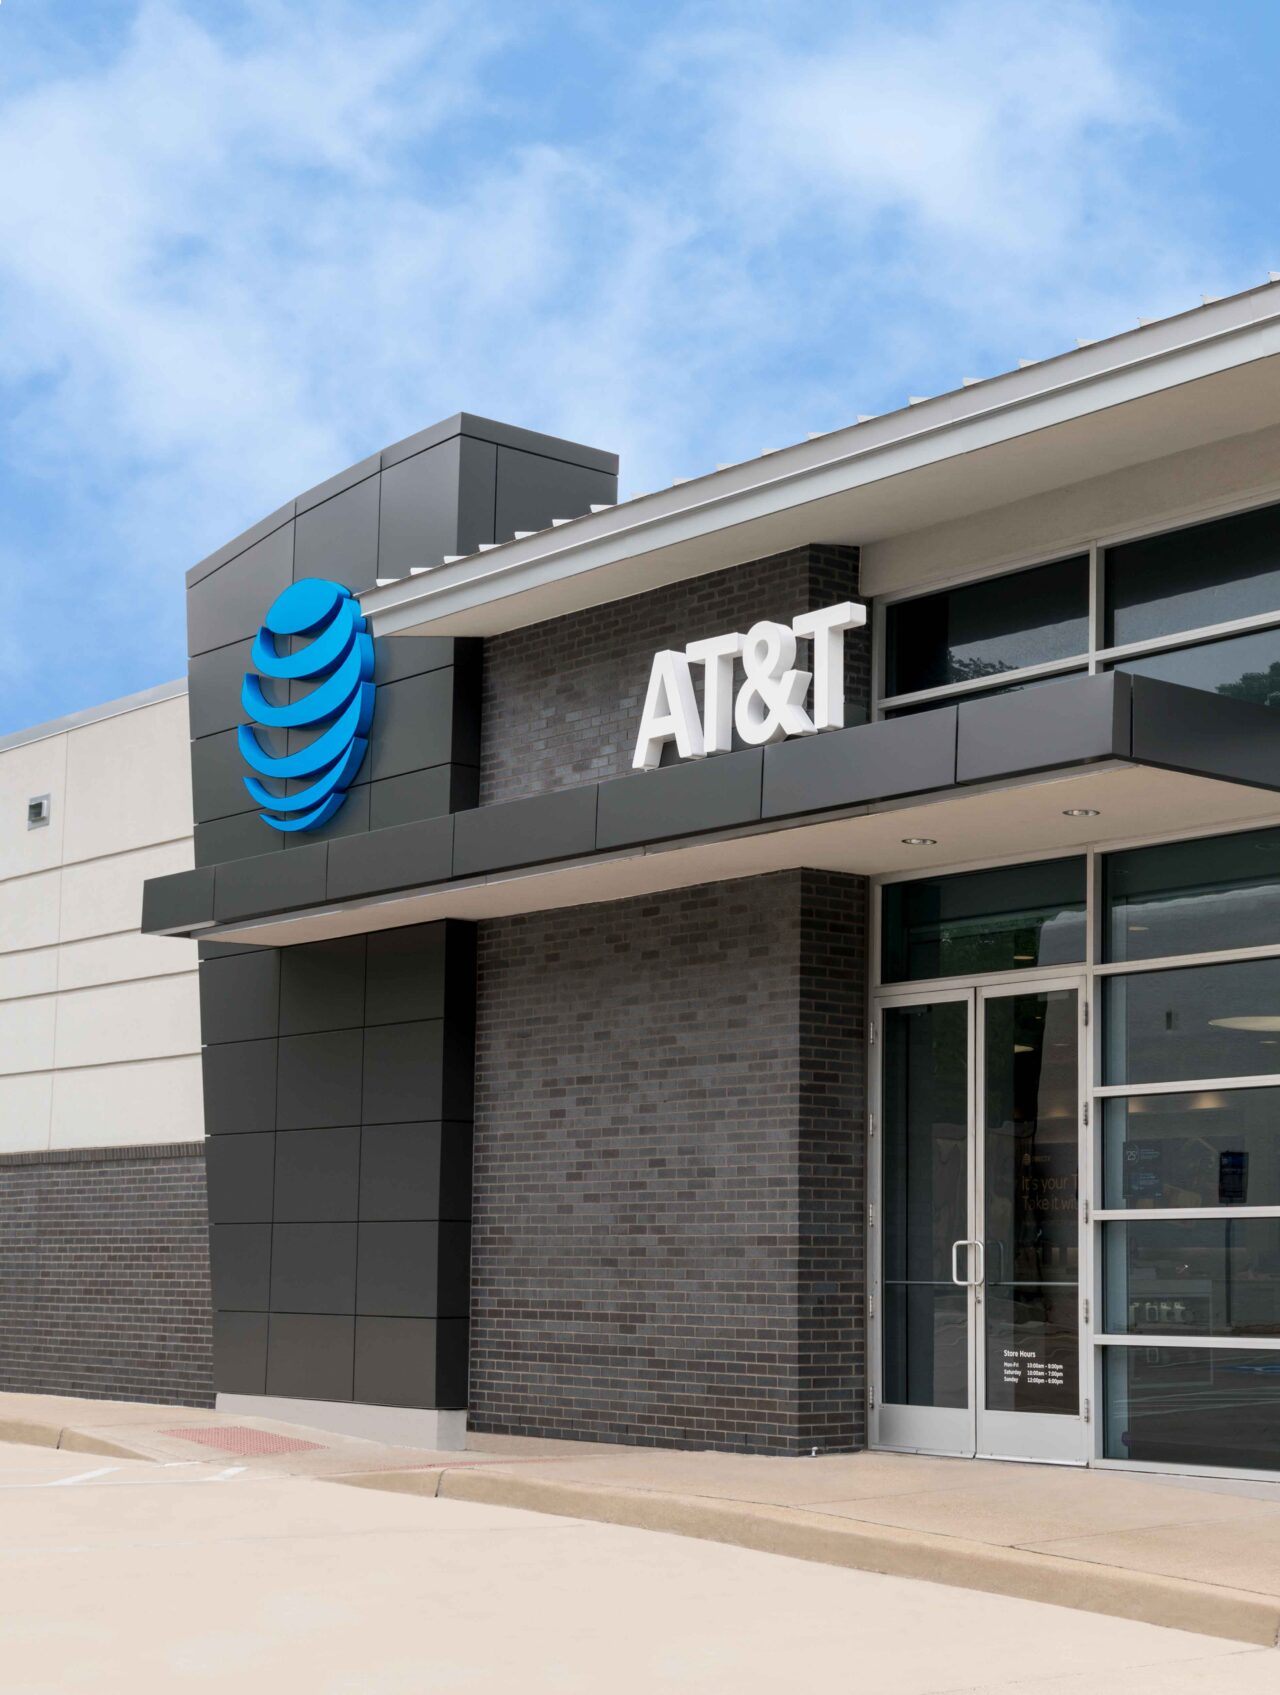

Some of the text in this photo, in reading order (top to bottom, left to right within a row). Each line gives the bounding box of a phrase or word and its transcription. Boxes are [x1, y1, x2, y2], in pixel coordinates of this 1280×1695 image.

[632, 601, 867, 769] AT&T
[1041, 1177, 1068, 1192] your
[1021, 1193, 1049, 1210] Take
[1051, 1194, 1059, 1210] it
[1003, 1349, 1036, 1358] Store Hours
